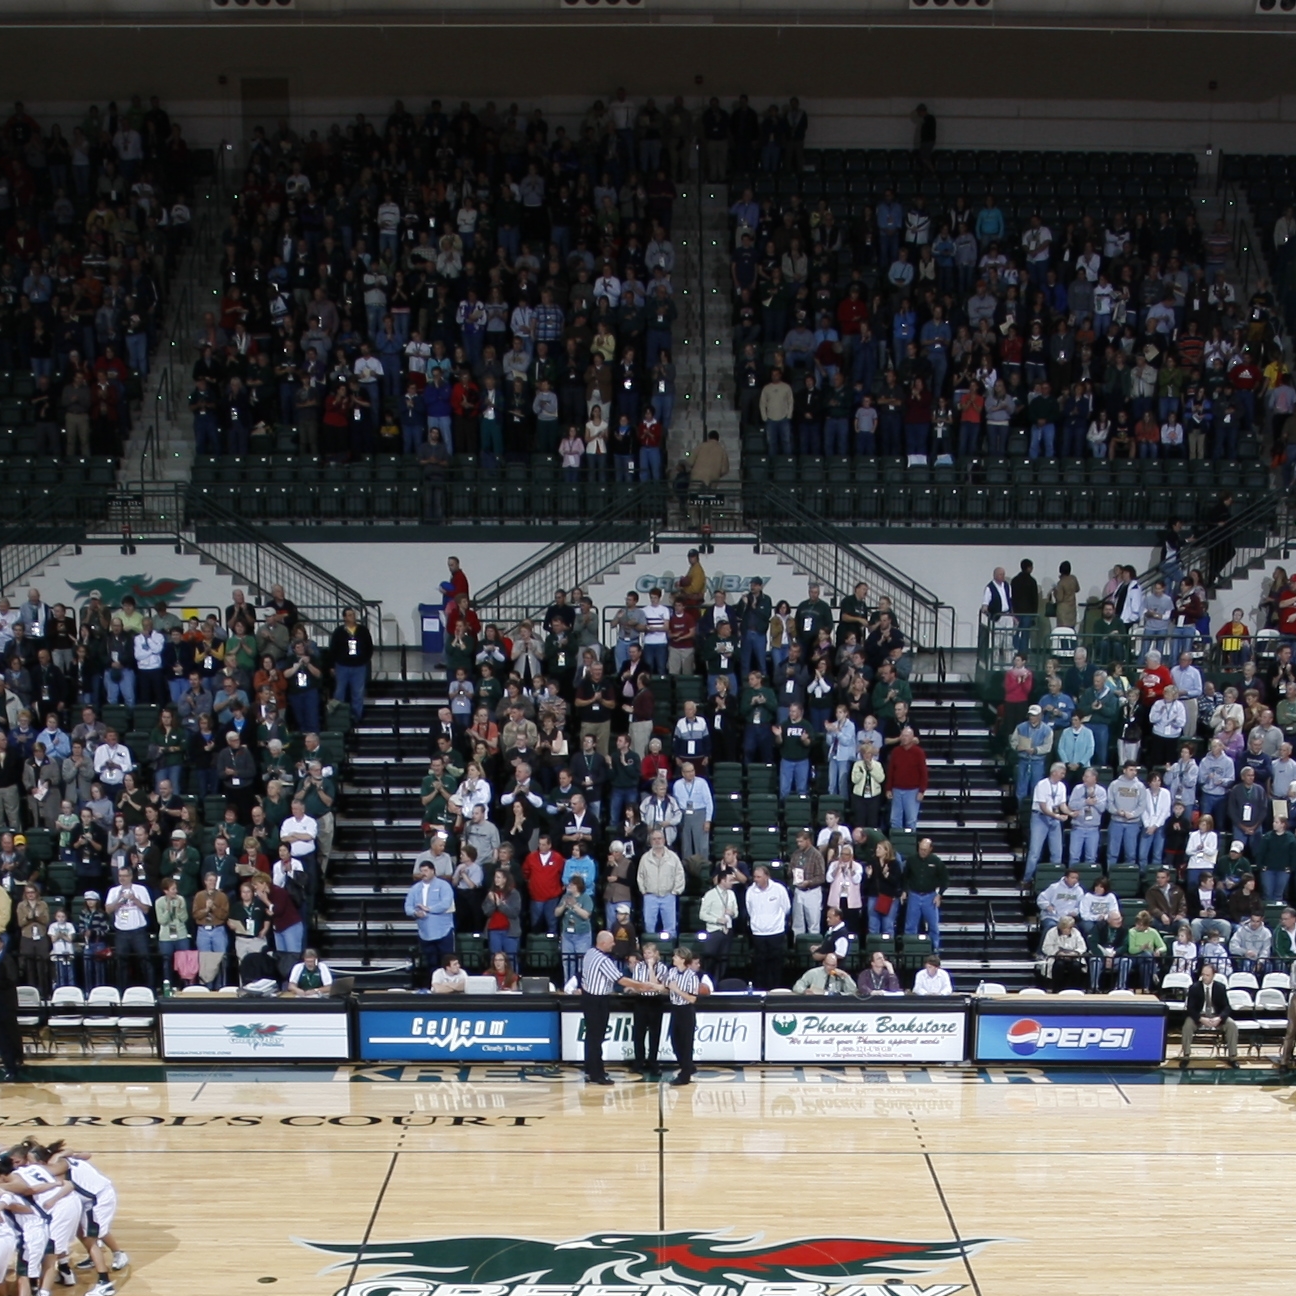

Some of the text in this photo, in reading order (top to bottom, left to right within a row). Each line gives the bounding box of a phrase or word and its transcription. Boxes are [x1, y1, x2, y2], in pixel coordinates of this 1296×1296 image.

[802, 1016, 957, 1034] Phoenix Bookstore
[1036, 1027, 1134, 1049] PEPSI
[279, 1114, 546, 1127] COURT
